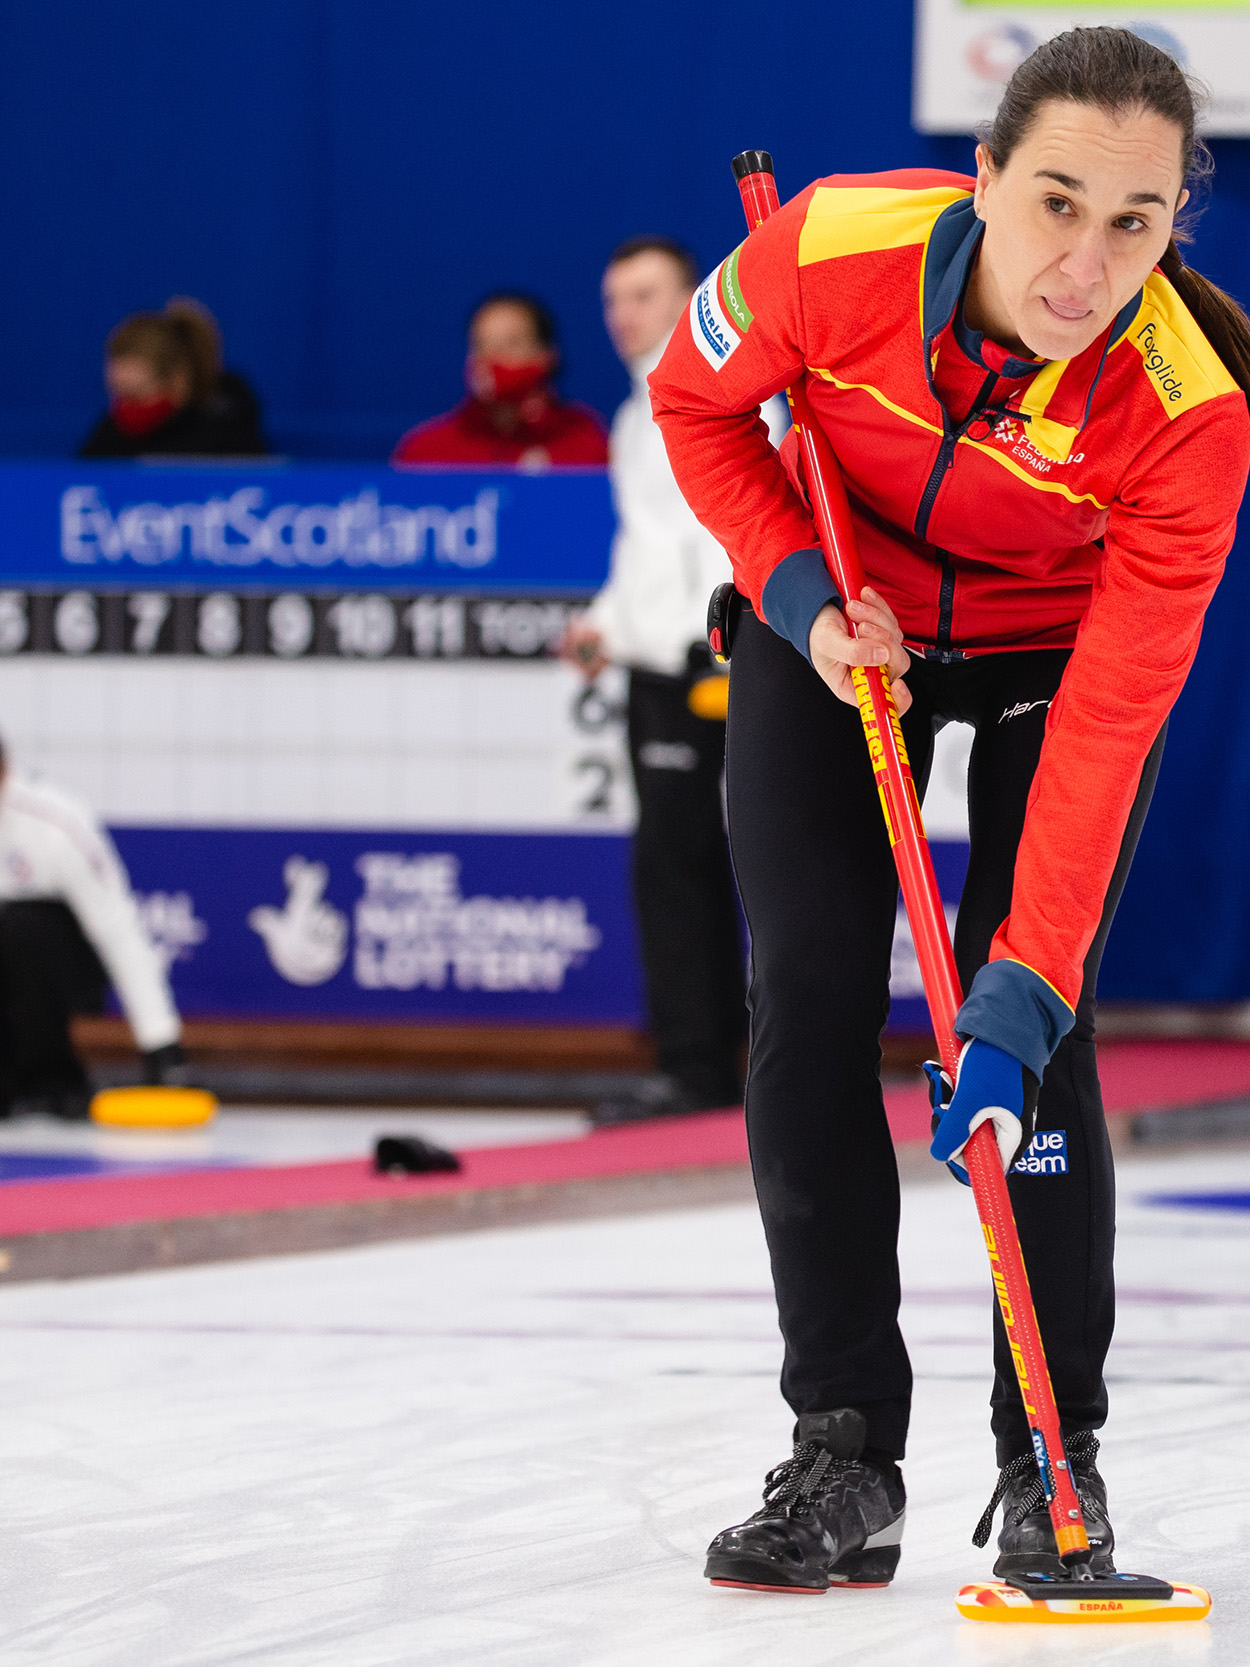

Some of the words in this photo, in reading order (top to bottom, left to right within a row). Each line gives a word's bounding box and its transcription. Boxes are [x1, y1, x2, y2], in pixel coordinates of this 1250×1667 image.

[702, 284, 731, 351] LOTERÍAS
[1012, 446, 1051, 473] ESPAÑA
[60, 486, 499, 568] EventScotland
[55, 590, 99, 656] 6
[127, 591, 172, 655] 7
[198, 590, 242, 657] 8
[267, 592, 314, 658] 9
[325, 593, 399, 659] 10
[402, 593, 466, 658] 11
[356, 852, 461, 898] THE
[355, 896, 601, 948] NATIONAL
[355, 942, 587, 992] LOTTERY
[1079, 1601, 1124, 1612] ESPAÑA
